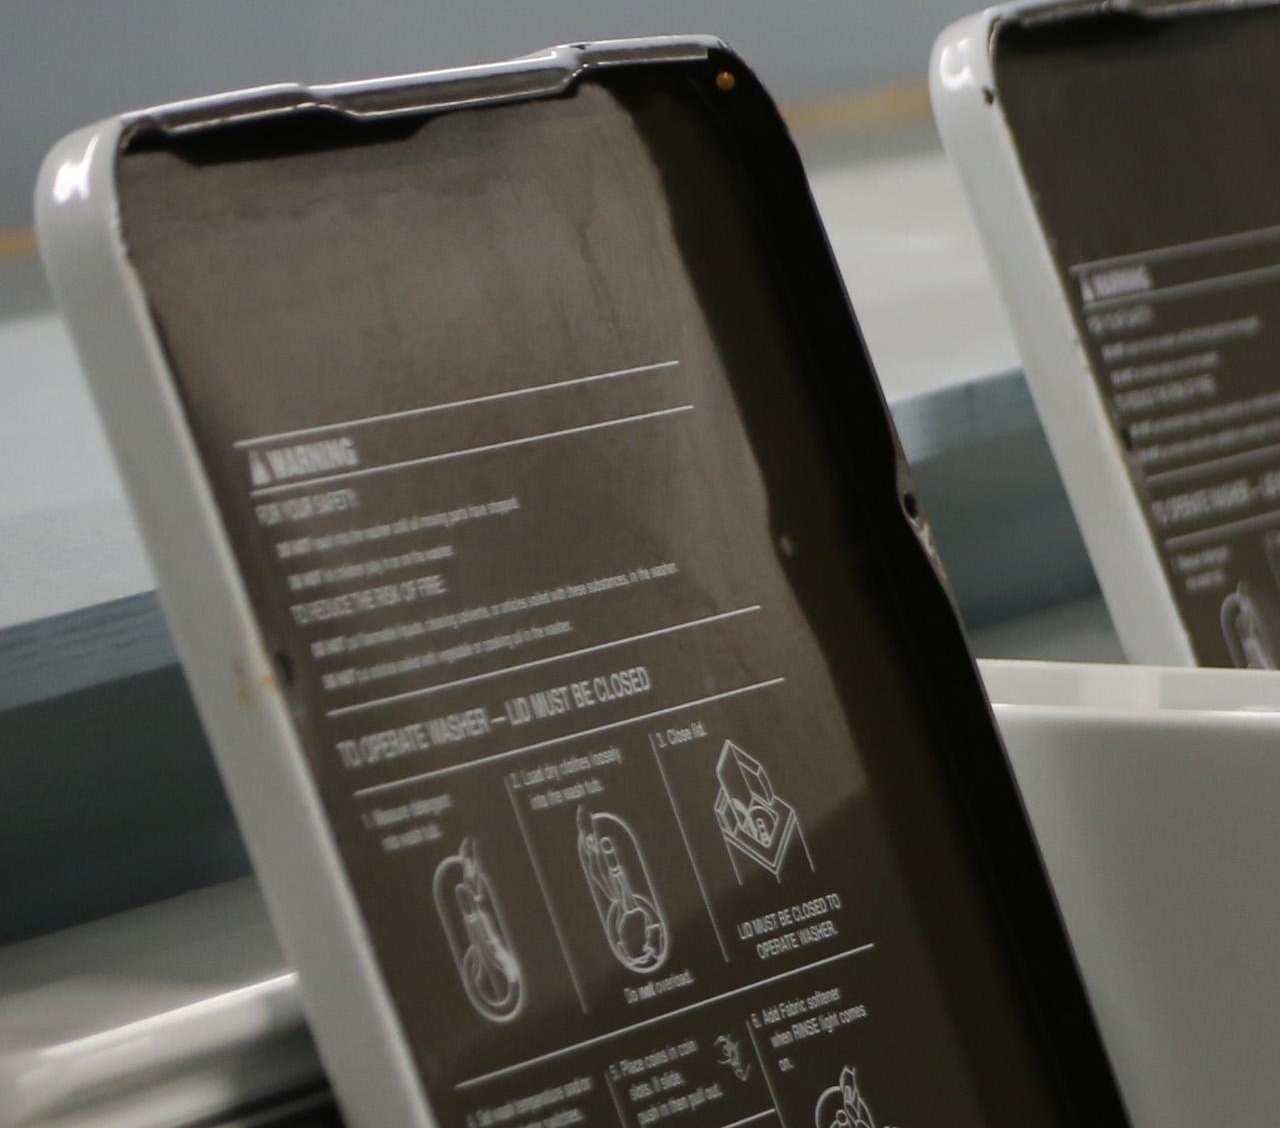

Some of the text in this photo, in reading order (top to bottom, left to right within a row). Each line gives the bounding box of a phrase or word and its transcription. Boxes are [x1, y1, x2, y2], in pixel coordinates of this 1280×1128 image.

[265, 435, 361, 480] WARNING
[335, 739, 364, 771] TO
[356, 721, 432, 765] OPERATE
[425, 706, 490, 747] WASHER
[503, 695, 532, 726] LID
[528, 685, 574, 720] MUST
[569, 679, 596, 709] BE
[590, 664, 652, 703] CLOSED
[654, 730, 668, 750] 3.
[664, 723, 694, 747] Close
[735, 891, 843, 942] LID MUST BE CLOSED TO
[755, 918, 840, 961] OPERATE WASHER.
[636, 979, 656, 1002] not
[759, 1004, 782, 1027] Add
[777, 994, 808, 1021] Fabric
[803, 983, 842, 1011] softener
[767, 999, 868, 1051] when RINSE light comes
[618, 1054, 646, 1079] Place
[776, 1053, 796, 1074] on.
